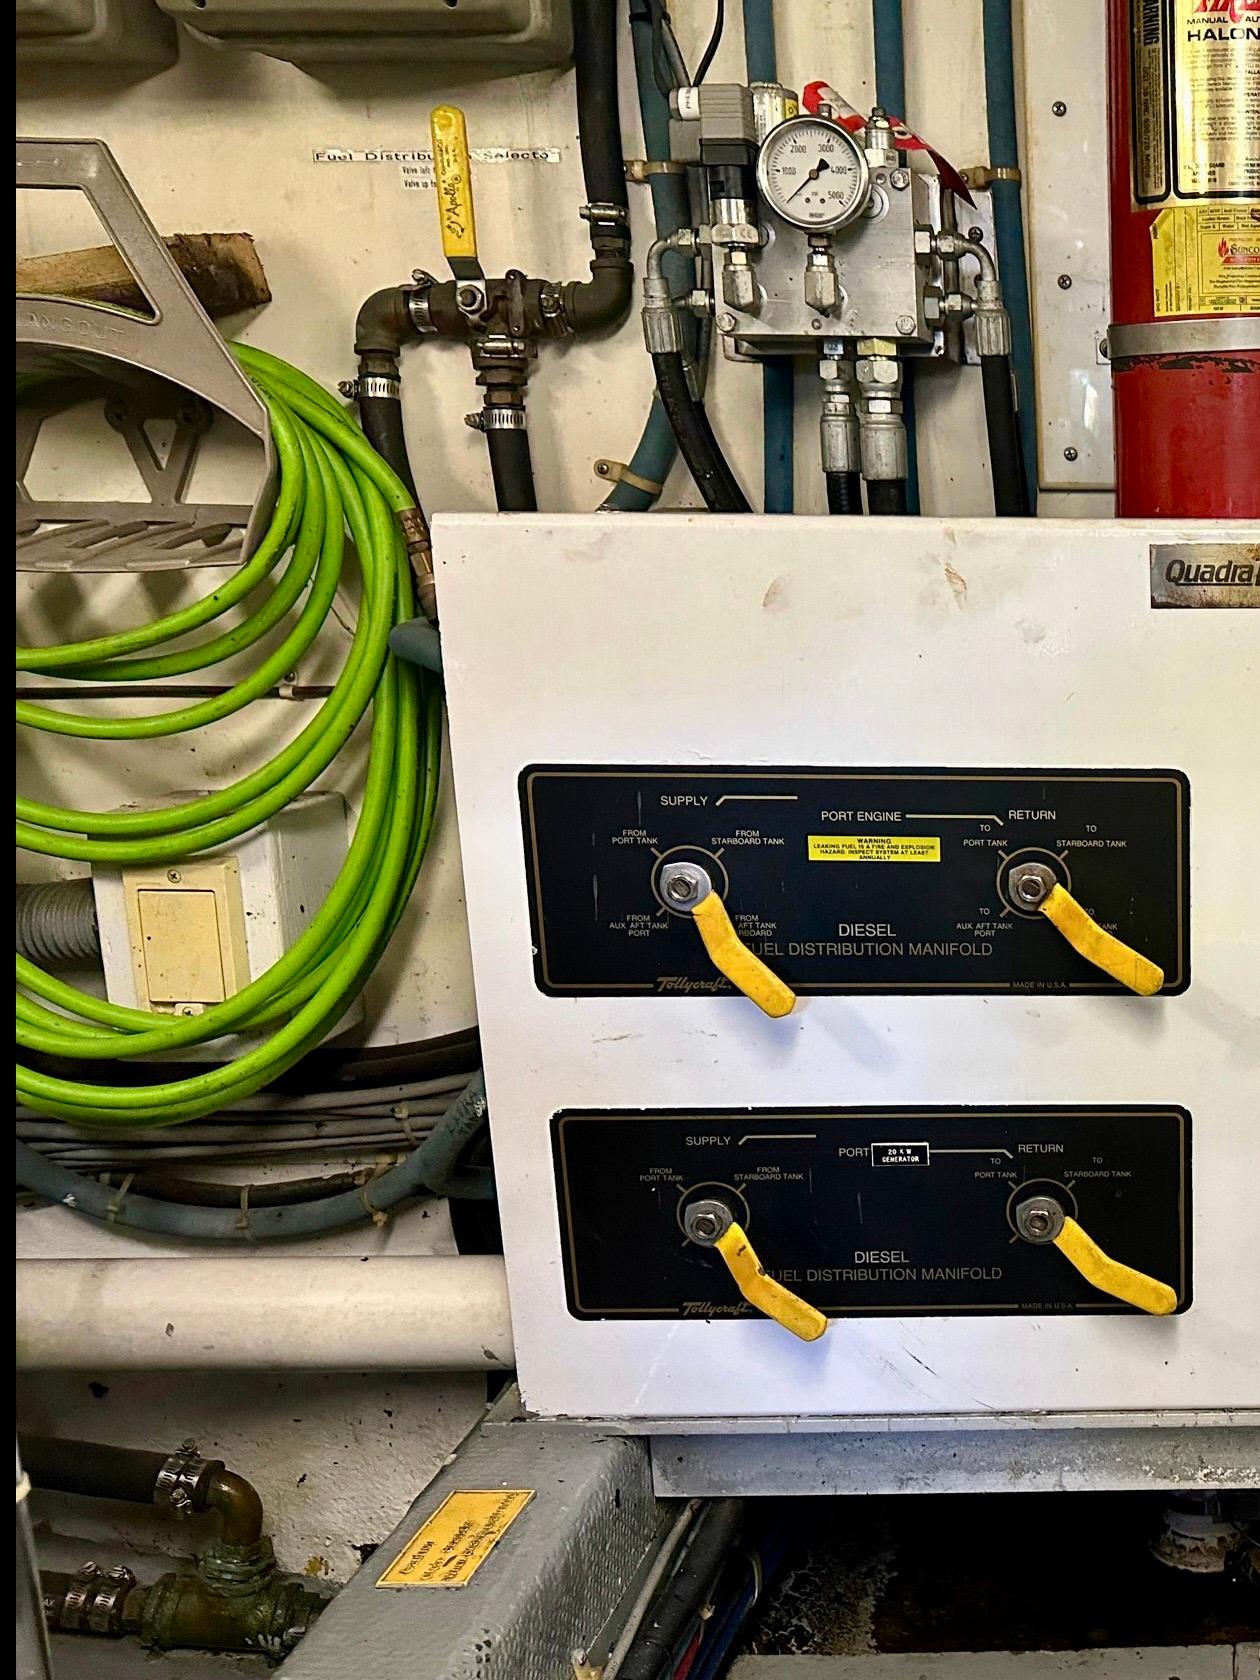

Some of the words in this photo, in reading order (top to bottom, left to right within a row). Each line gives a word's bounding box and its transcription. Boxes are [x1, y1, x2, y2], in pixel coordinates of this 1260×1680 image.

[1186, 16, 1228, 25] MANUAL
[790, 144, 807, 153] 2000
[818, 143, 834, 152] 3000
[315, 152, 353, 162] Fuel
[782, 166, 796, 175] 1000
[830, 166, 847, 175] 4000
[828, 190, 844, 200] 5000
[660, 795, 708, 806] SUPPLY
[821, 811, 854, 822] PORT
[857, 811, 902, 822] ENGINE
[1008, 810, 1056, 820] RETURN
[979, 824, 991, 832] TO
[1085, 825, 1097, 833] TO
[622, 829, 647, 837] FROM
[735, 829, 760, 837] FROM
[611, 837, 634, 845] PORT
[636, 837, 658, 845] TANK
[711, 837, 762, 845] STARBOARD
[763, 837, 785, 845] TANK
[963, 839, 985, 847] PORT
[986, 839, 1008, 847] TANK
[1056, 839, 1105, 848] STARBOARD
[1106, 839, 1127, 848] TANK
[978, 907, 990, 915] TO
[626, 914, 651, 922] FROM
[735, 914, 759, 922] FROM
[609, 922, 626, 930] AUX
[630, 922, 647, 930] AFT
[647, 922, 669, 930] TANK
[738, 922, 754, 930] AFT
[755, 922, 777, 930] TANK
[838, 923, 897, 937] DIESEL
[956, 922, 972, 930] AUX
[975, 922, 992, 930] AFT
[993, 922, 1013, 930] TANK
[628, 929, 650, 937] PORT
[974, 929, 996, 937] PORT
[788, 942, 904, 956] DISTRIBUTION
[908, 942, 993, 956] MANIFOLD
[656, 976, 728, 993] Tollycraft
[1012, 981, 1036, 989] MADE
[1037, 981, 1045, 989] IN
[685, 1135, 731, 1147] SUPPLY
[838, 1147, 870, 1157] PORT
[1018, 1143, 1064, 1154] RETURN
[882, 1155, 920, 1163] GENERATOR
[990, 1157, 1002, 1165] TO
[1092, 1156, 1103, 1164] TO
[649, 1167, 673, 1175] FROM
[756, 1166, 780, 1174] FROM
[1063, 1170, 1110, 1178] STARBOARD
[1111, 1170, 1132, 1178] TANK
[639, 1174, 661, 1182] PORT
[662, 1174, 684, 1182] TANK
[733, 1173, 782, 1181] STARBOARD
[783, 1173, 804, 1181] TANK
[974, 1171, 996, 1179] PORT
[997, 1171, 1017, 1179] TANK
[854, 1250, 910, 1264] DIESEL
[806, 1267, 917, 1282] DISTRIBUTION
[921, 1266, 1002, 1281] MANIFOLD
[681, 1301, 749, 1316] Tollycraft
[1021, 1302, 1043, 1310] MADE
